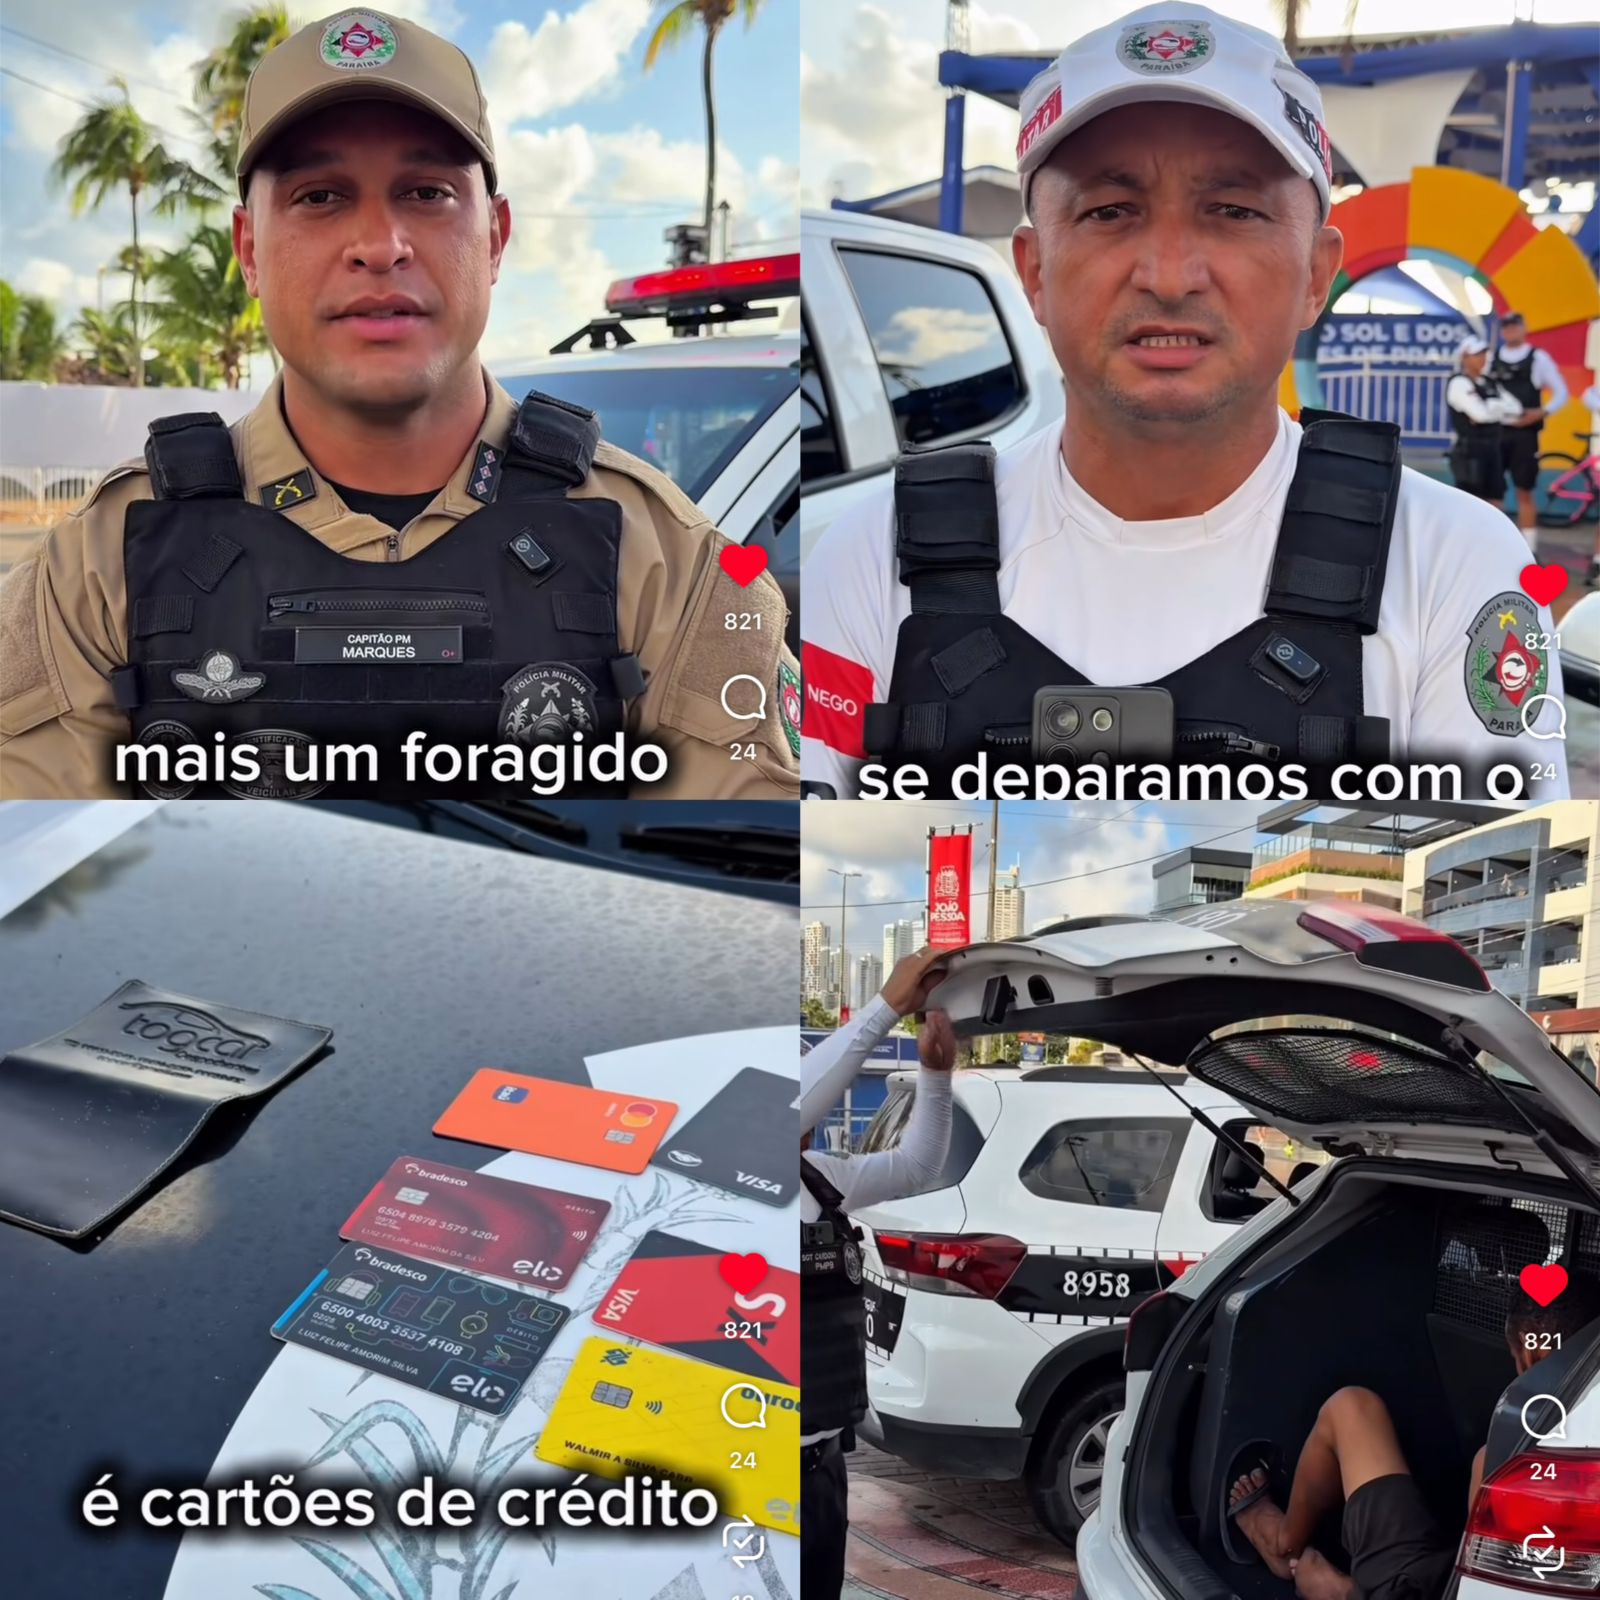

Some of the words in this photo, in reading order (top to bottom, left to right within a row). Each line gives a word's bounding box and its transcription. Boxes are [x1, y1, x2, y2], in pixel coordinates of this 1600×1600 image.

[1340, 322, 1390, 342] SOL
[1393, 322, 1410, 342] E
[347, 632, 394, 644] CAPITÃO
[395, 635, 411, 644] PM
[342, 646, 416, 659] MARQUES
[551, 670, 587, 695] MILITAR
[807, 682, 858, 717] NEGO
[930, 911, 966, 922] PESSOA
[417, 1168, 469, 1188] bradesco
[735, 1170, 783, 1195] VISA
[378, 1205, 407, 1220] 6504
[470, 1227, 501, 1243] 4204
[370, 1255, 428, 1282] bradesco
[512, 1259, 564, 1282] elo
[1062, 1270, 1131, 1298] 8958
[600, 1287, 640, 1322] VISA
[320, 1300, 355, 1319] 6500
[355, 1311, 390, 1331] 4003
[390, 1323, 426, 1343] 3537
[427, 1335, 464, 1357] 4108
[298, 1327, 320, 1341] LUIZ
[319, 1334, 352, 1353] FELIPE
[352, 1347, 392, 1366] AMORIM
[392, 1359, 419, 1377] SILVA
[450, 1373, 505, 1404] elo
[564, 1440, 612, 1461] WALMIR
[613, 1455, 622, 1464] A
[623, 1457, 657, 1475] SILVA
